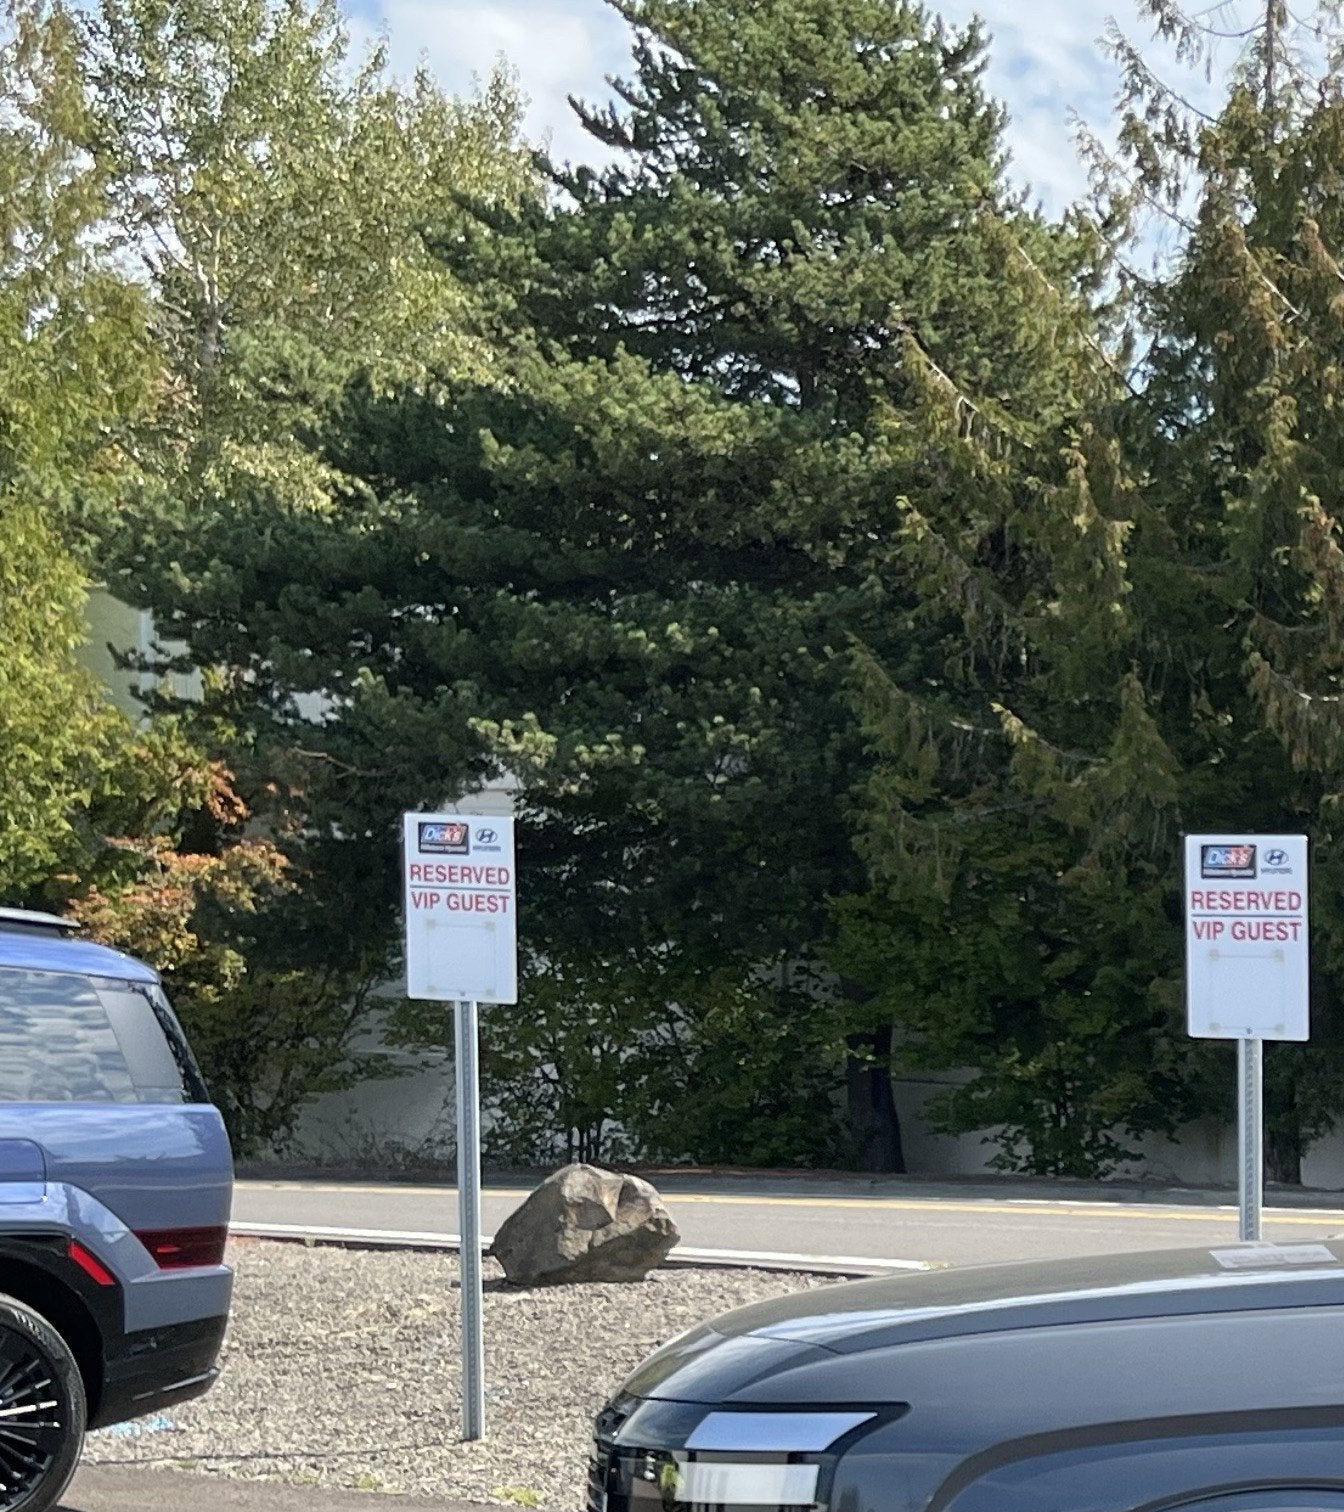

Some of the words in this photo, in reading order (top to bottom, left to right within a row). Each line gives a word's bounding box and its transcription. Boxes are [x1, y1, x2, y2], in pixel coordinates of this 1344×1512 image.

[410, 864, 510, 886] RESERVED
[411, 891, 441, 910] VIP
[446, 892, 511, 914] GUEST
[1191, 891, 1302, 911] RESERVED
[1193, 921, 1224, 941] VIP
[1231, 921, 1302, 942] GUEST
